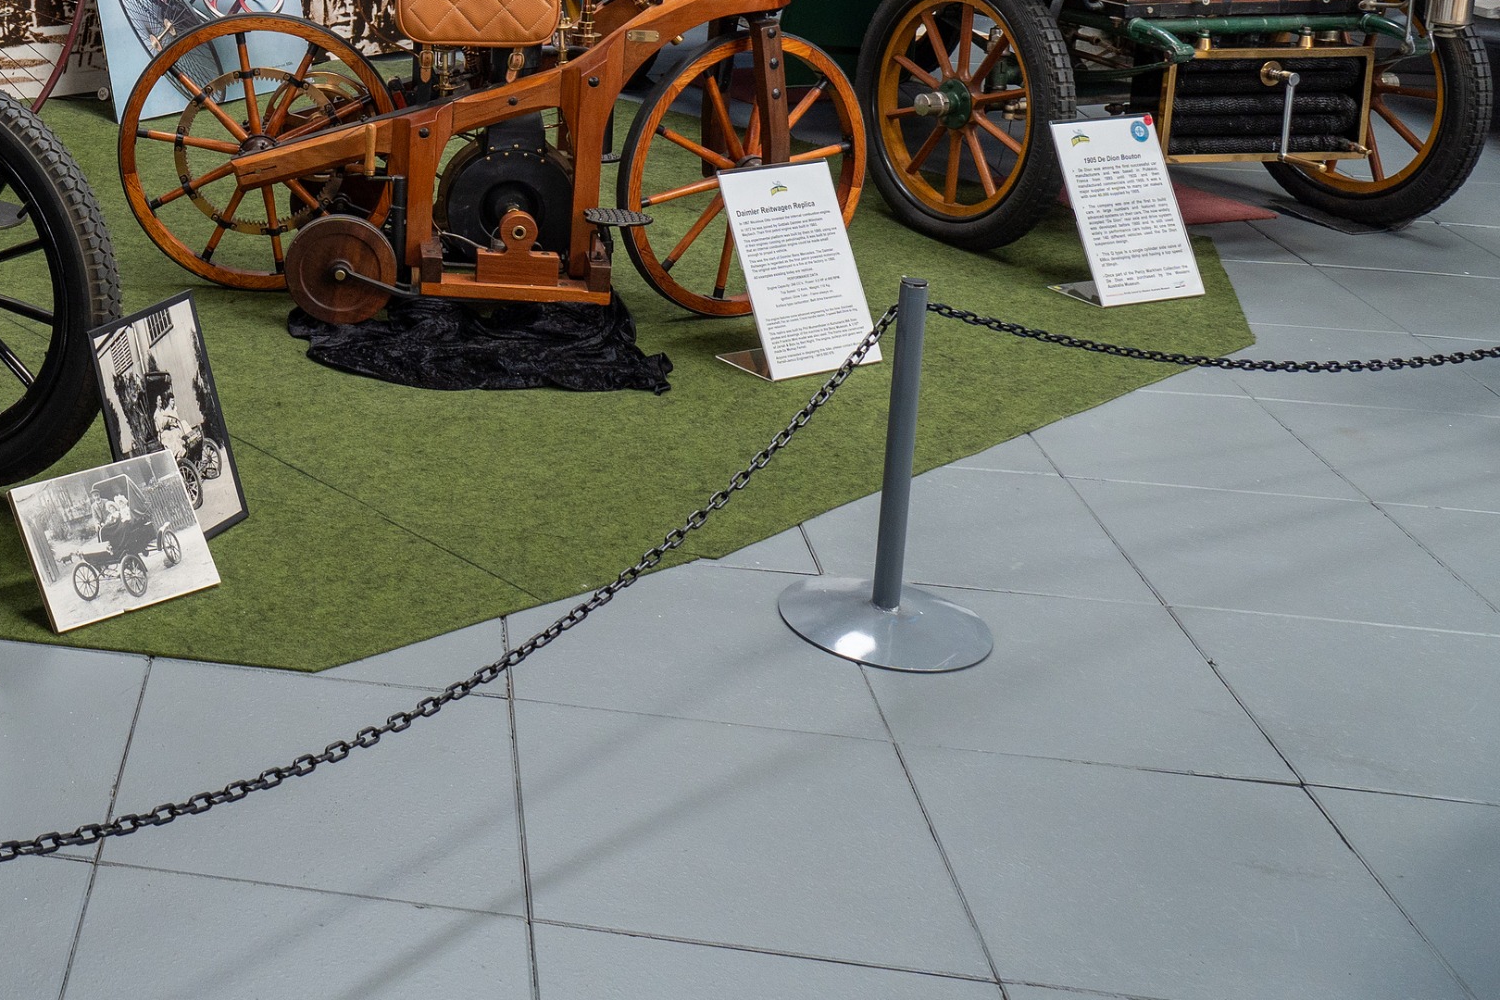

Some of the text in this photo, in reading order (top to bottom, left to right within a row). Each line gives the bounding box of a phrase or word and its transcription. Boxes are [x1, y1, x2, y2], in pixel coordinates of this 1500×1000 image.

[735, 200, 815, 217] Daimler Reitwagen Replica
